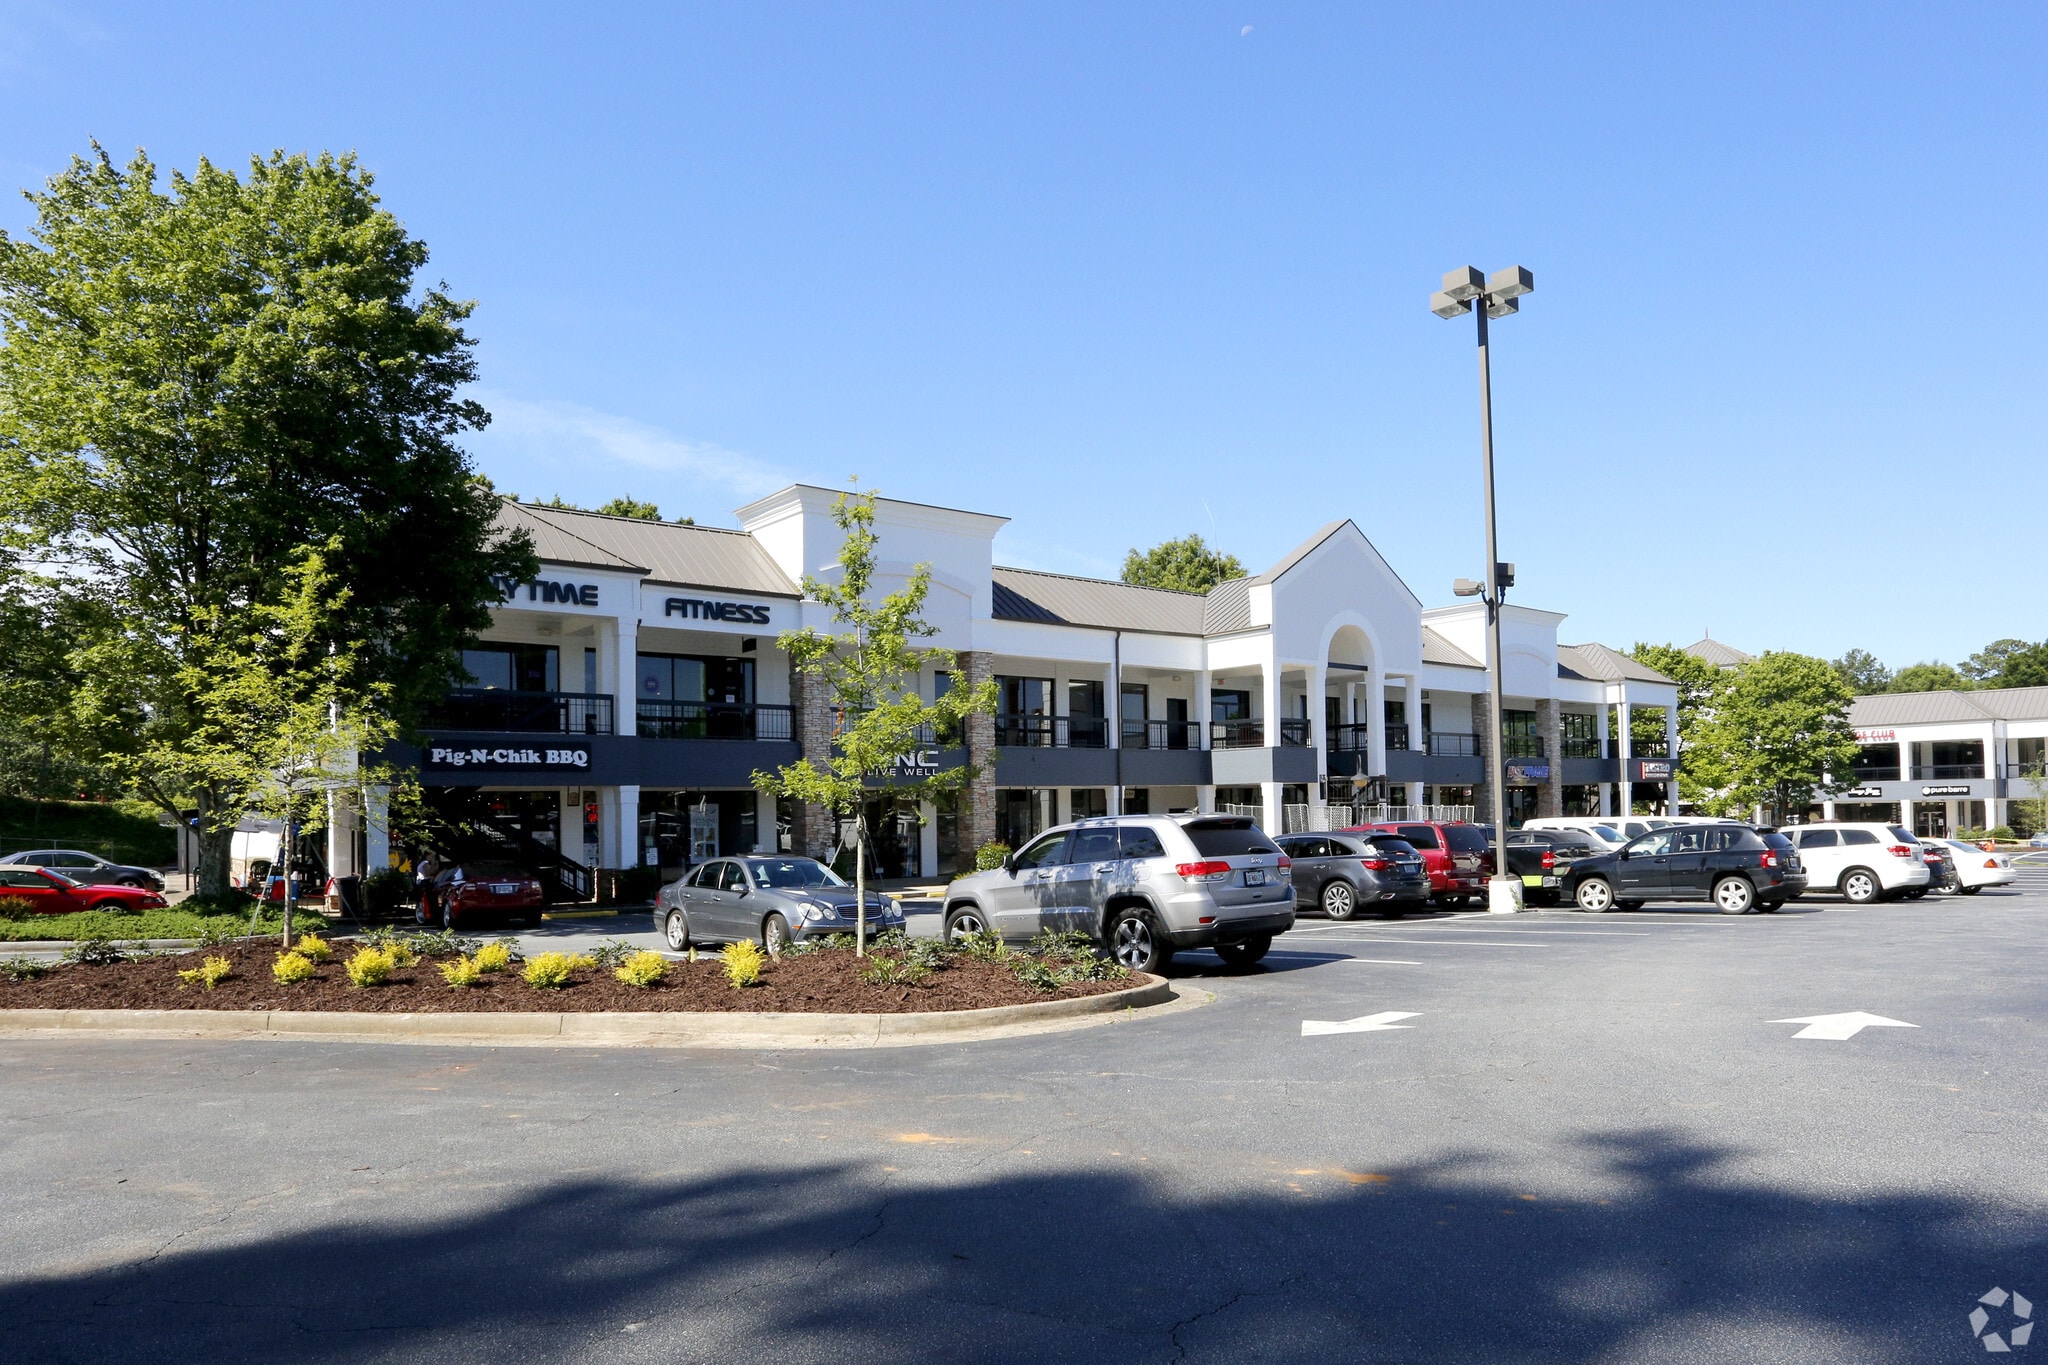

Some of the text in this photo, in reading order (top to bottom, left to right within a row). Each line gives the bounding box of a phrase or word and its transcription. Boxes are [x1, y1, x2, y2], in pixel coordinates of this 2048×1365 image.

[489, 576, 599, 607] YTIME
[665, 597, 771, 625] FITNESS
[431, 748, 588, 768] Pig-N-Chik BBQ
[892, 750, 939, 767] NC
[867, 768, 938, 776] LIVE WELL
[1930, 787, 1948, 795] pure
